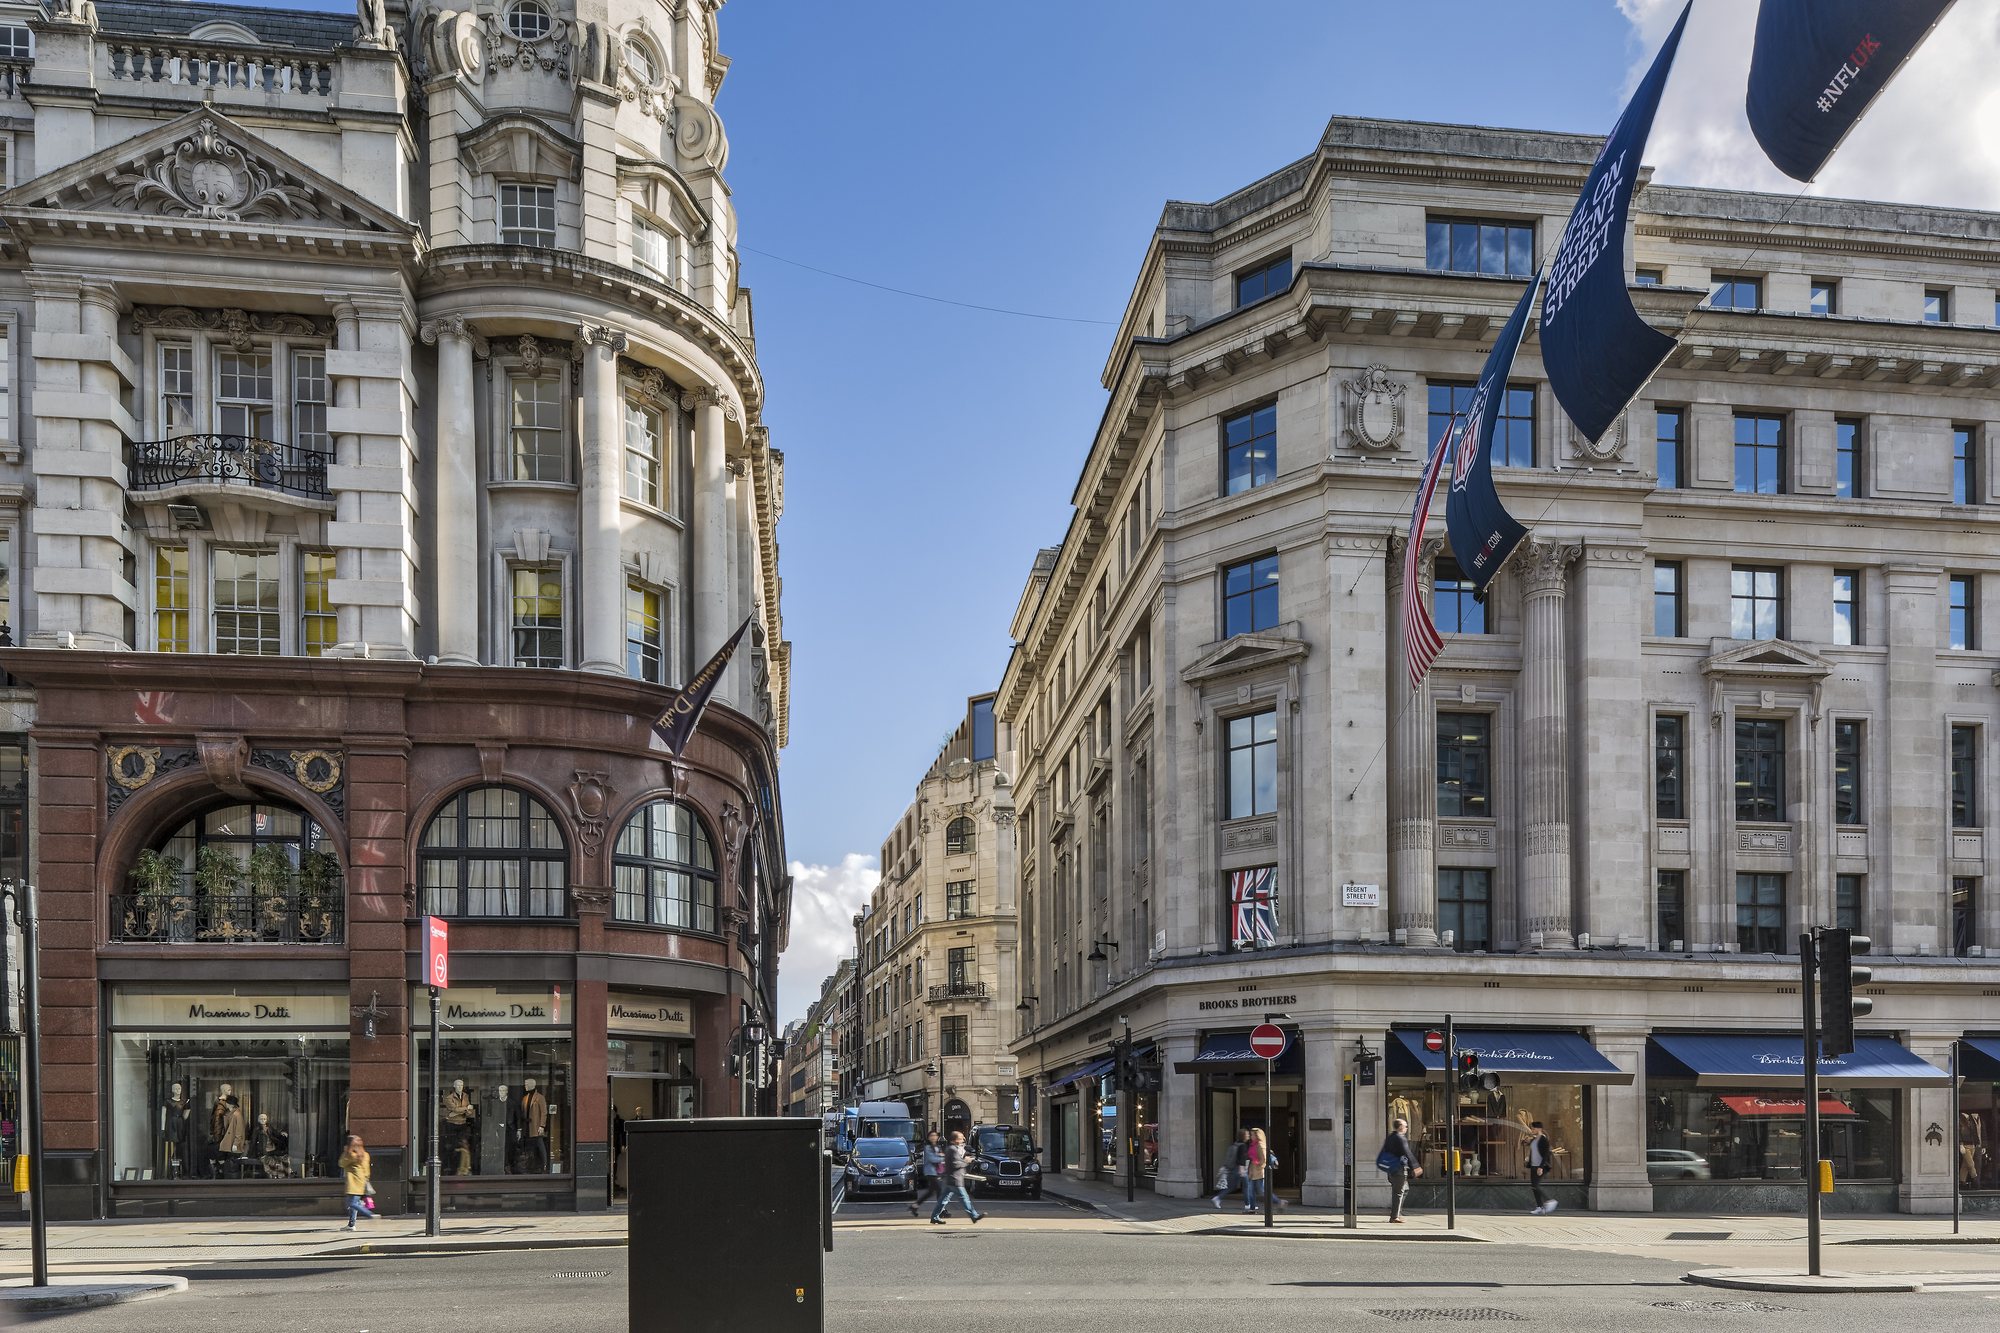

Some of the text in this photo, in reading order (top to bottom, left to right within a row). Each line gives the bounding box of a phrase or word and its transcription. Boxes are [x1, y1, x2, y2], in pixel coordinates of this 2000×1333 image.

[1817, 33, 1881, 113] #NFLUK
[1557, 149, 1627, 262] NFL ON
[1547, 177, 1624, 297] REGENT
[1546, 213, 1615, 327] STREET
[1473, 530, 1502, 569] NFL.COM
[188, 1004, 291, 1019] Massimo Dutti
[447, 1004, 546, 1019] Massimo Dutti
[1199, 995, 1297, 1011] BROOKS BROTHERS
[610, 1004, 684, 1023] Massimo Dutti
[1498, 1047, 1555, 1060] Brothers
[1751, 1053, 1799, 1065] Brooks
